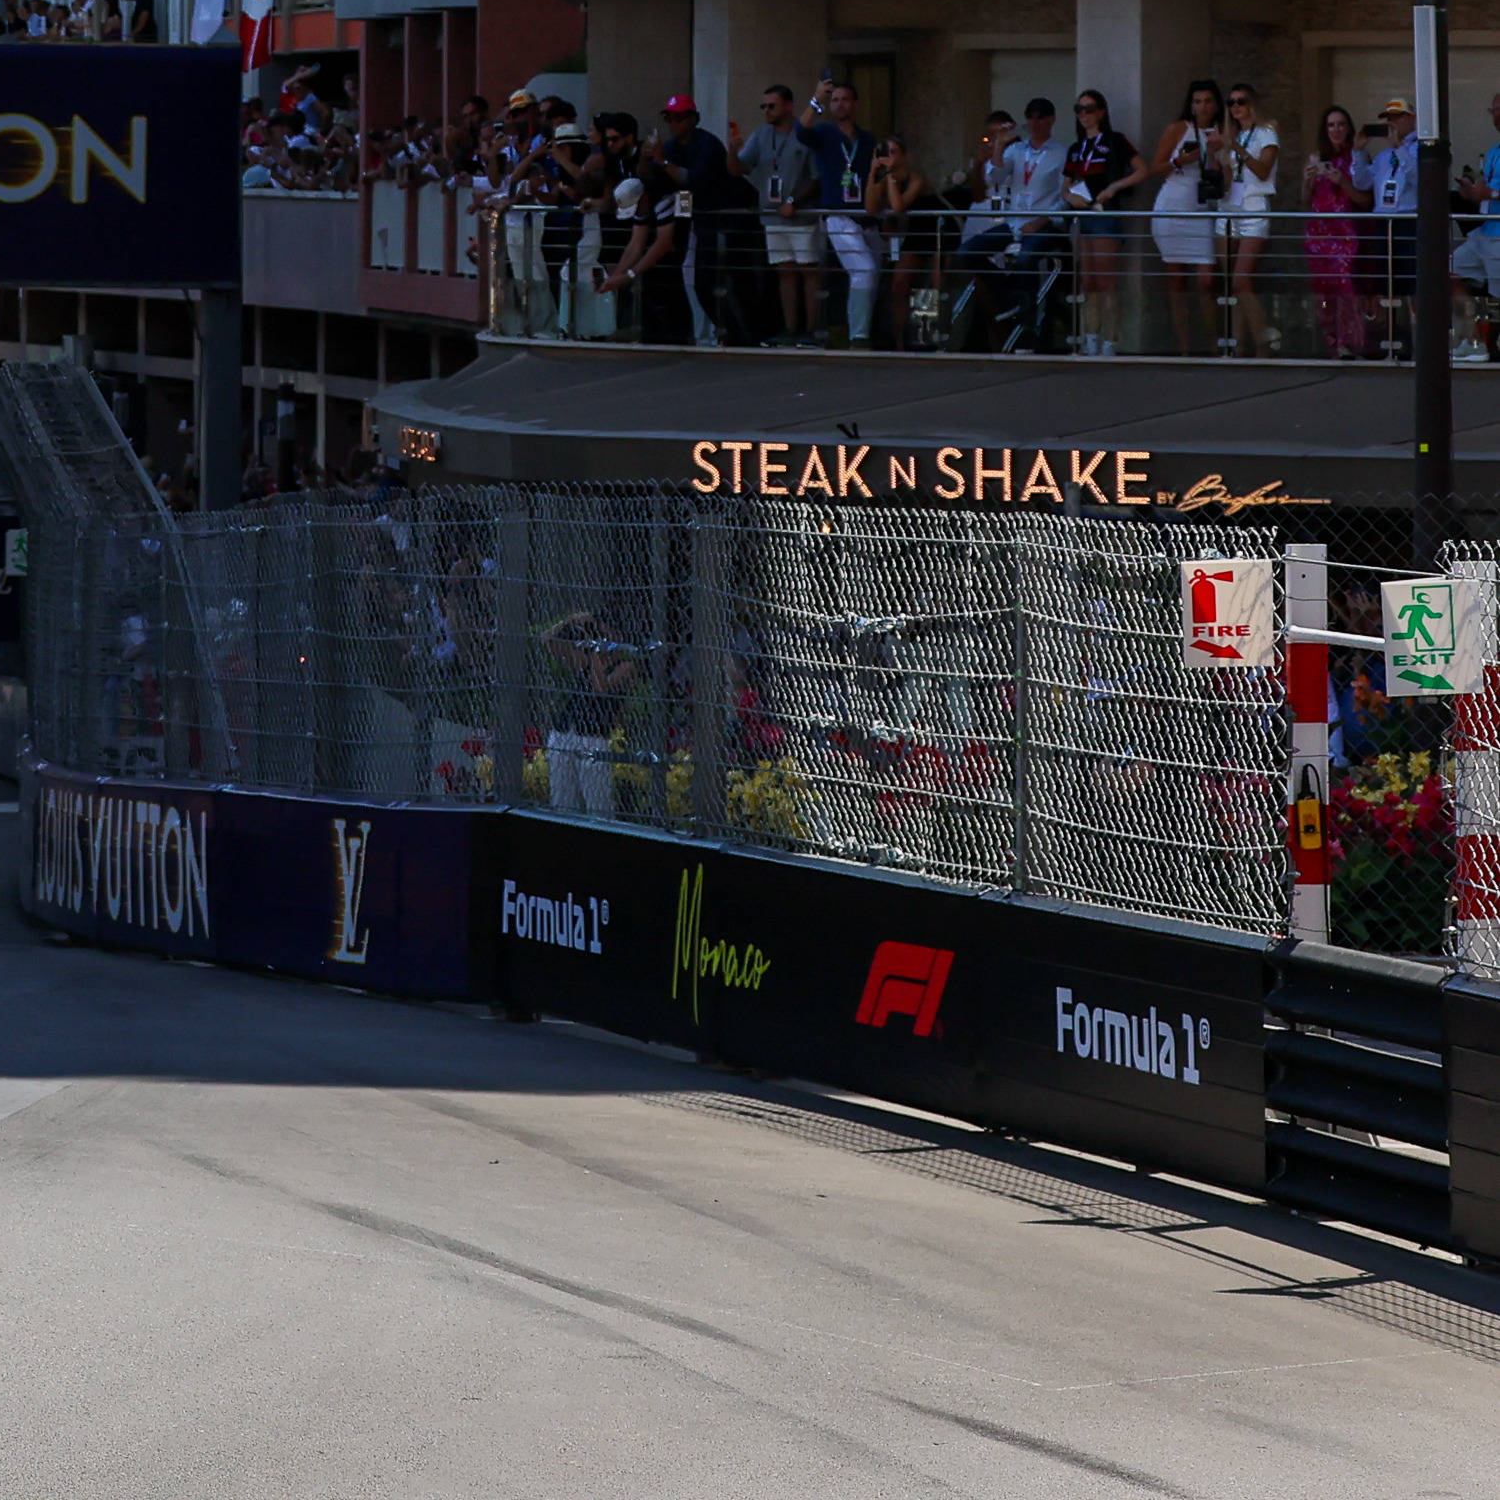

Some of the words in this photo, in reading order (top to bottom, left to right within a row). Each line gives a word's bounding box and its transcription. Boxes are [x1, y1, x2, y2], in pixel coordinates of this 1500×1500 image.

[692, 441, 873, 498] STEAK
[890, 456, 916, 490] N
[934, 447, 1151, 506] SHAKE
[1157, 491, 1176, 505] BY
[1193, 625, 1250, 638] FIRE
[1393, 653, 1455, 666] EXIT
[37, 788, 83, 914] LOUIS
[88, 795, 209, 939] VUITTON
[332, 818, 372, 964] LV
[502, 879, 585, 950] Formula
[673, 863, 771, 1026] Monaco
[1056, 986, 1176, 1080] Formula
